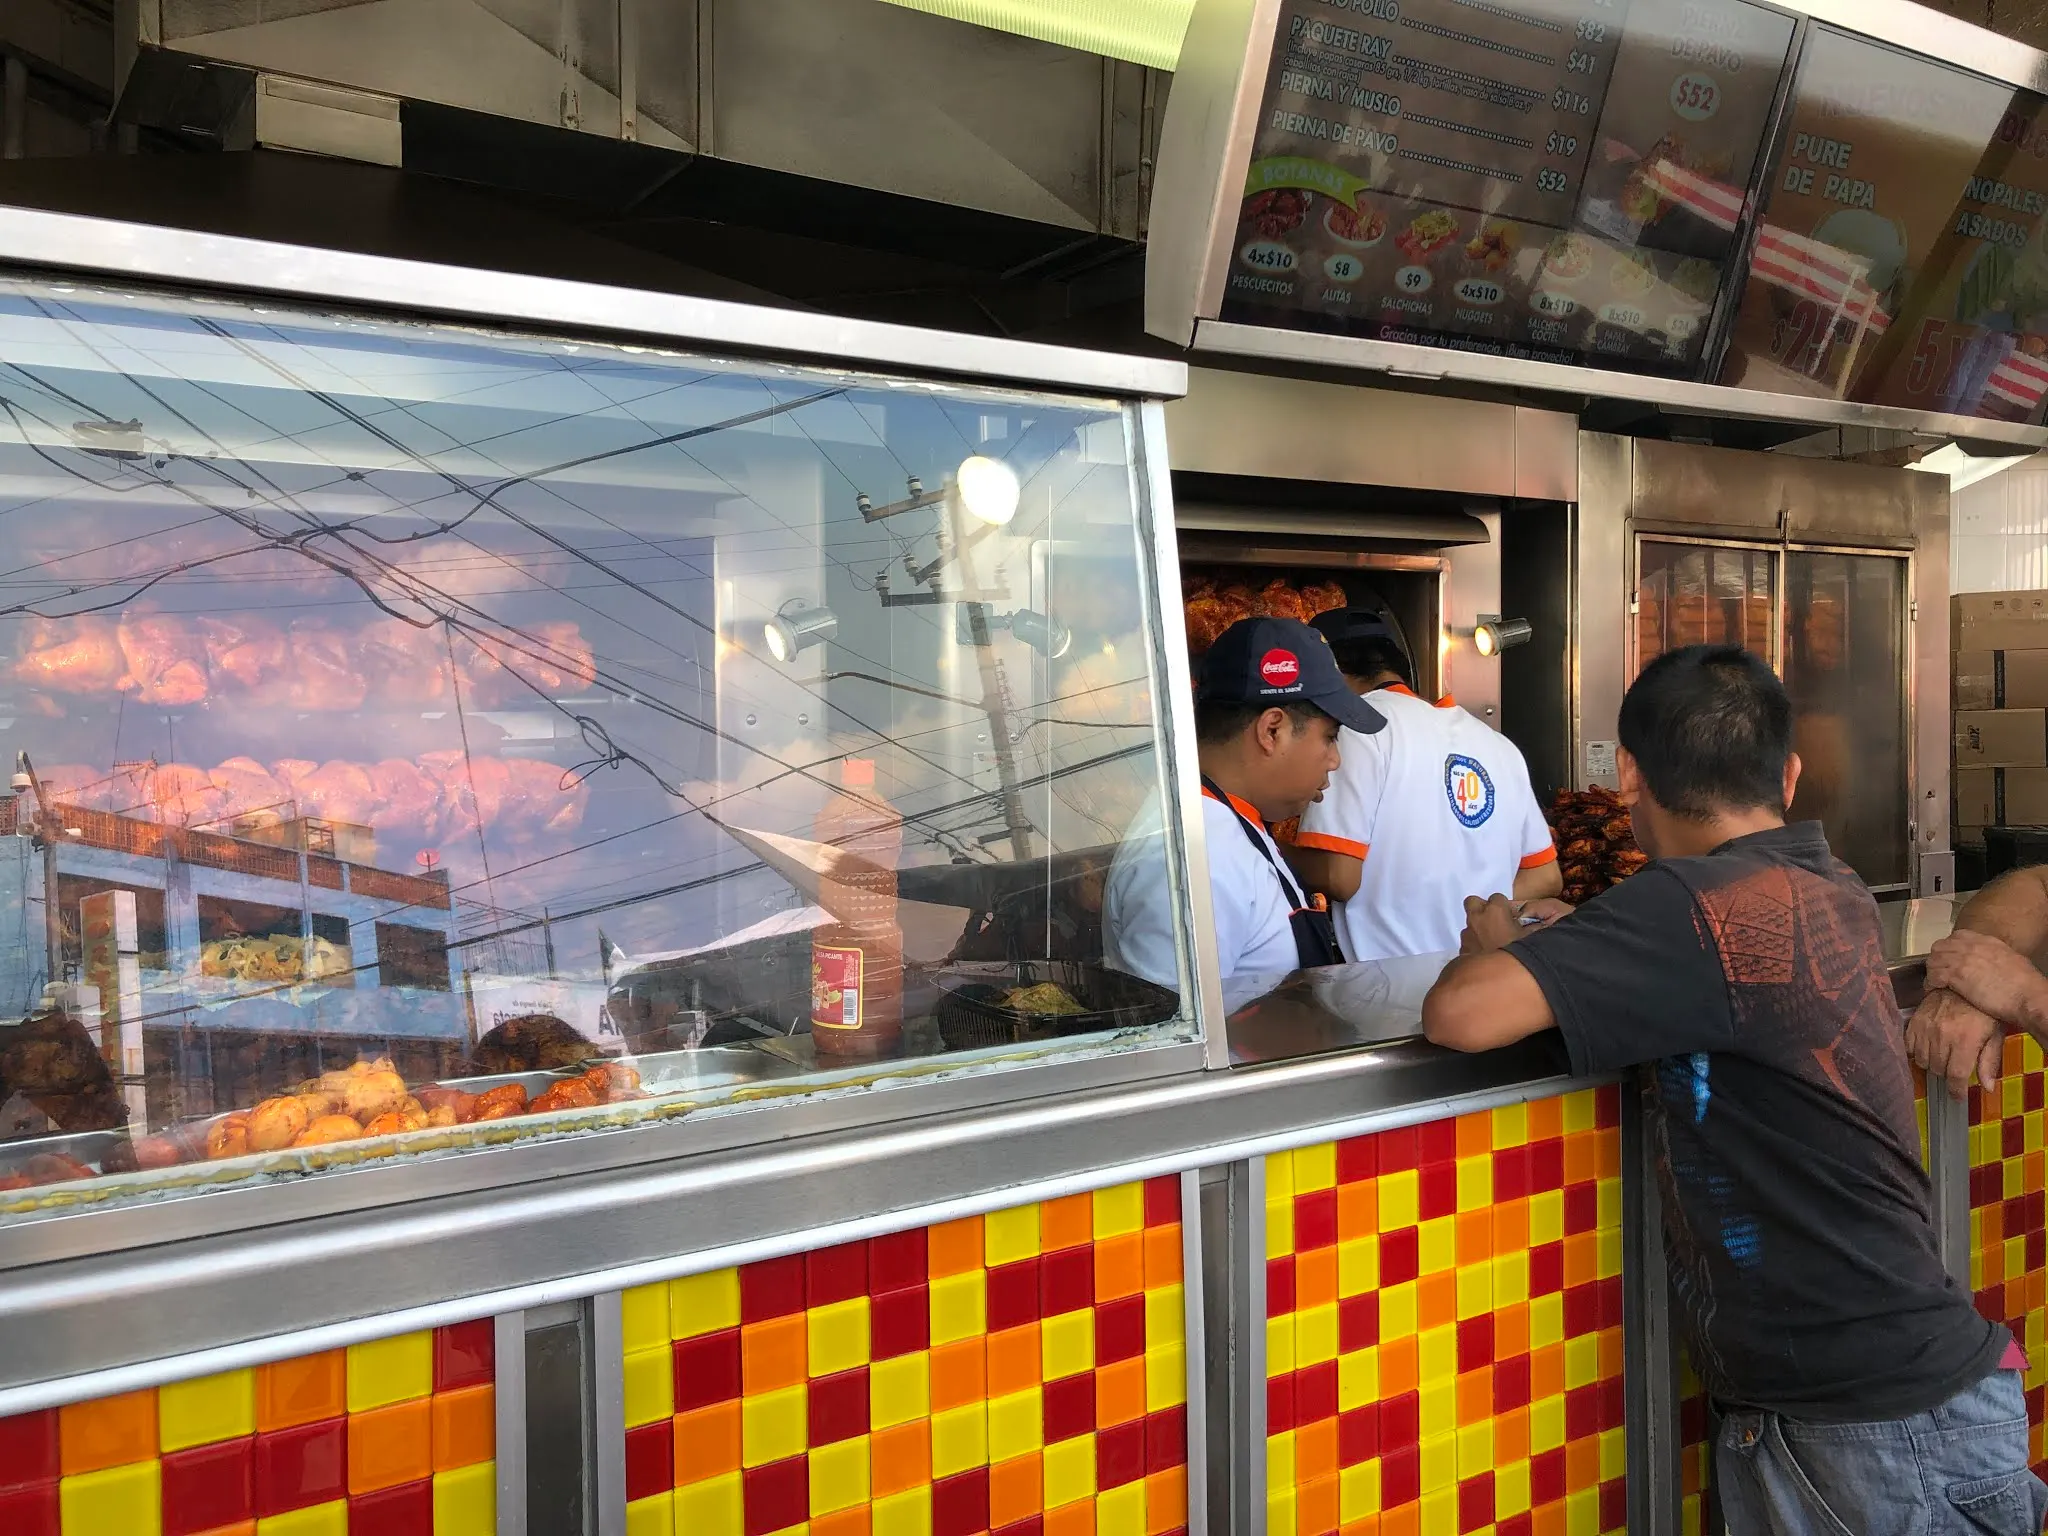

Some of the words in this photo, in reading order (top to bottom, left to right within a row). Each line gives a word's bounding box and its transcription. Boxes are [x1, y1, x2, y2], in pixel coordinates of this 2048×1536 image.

[1575, 17, 1606, 43] $82
[1290, 15, 1359, 51] PAQUETE
[1360, 33, 1392, 59] RAY
[1552, 88, 1589, 115] $116
[1566, 48, 1597, 75] $41
[1671, 37, 1694, 58] DE
[1698, 39, 1743, 73] PAVO
[1319, 50, 1344, 64] papas
[1462, 85, 1478, 98] vaso
[1479, 88, 1488, 100] de
[1322, 66, 1337, 77] con
[1677, 77, 1714, 112] $52
[1280, 69, 1333, 101] PIERNA
[1338, 84, 1349, 104] Y
[1350, 87, 1401, 116] MUSLO
[1546, 130, 1577, 157] $19
[1272, 110, 1328, 139] PIERNA
[1331, 122, 1352, 144] DE
[1354, 127, 1398, 154] PAVO
[1537, 167, 1567, 192] $52
[1791, 132, 1852, 169] PURE
[1263, 163, 1345, 193] BOTANAS
[1783, 165, 1816, 195] DE
[1822, 173, 1875, 208] PAPA
[1964, 174, 2045, 215] NOPALES
[1955, 210, 2028, 248] ASADOS
[1248, 248, 1292, 269] 4x$10
[1334, 260, 1351, 277] $8
[1232, 275, 1293, 296] PESCUECITOS
[1405, 272, 1421, 288] $9
[1461, 284, 1498, 301] 4x$10
[1381, 297, 1433, 315] SALCHICHAS
[1455, 308, 1494, 324] NUGGETS
[1380, 325, 1418, 343] Gracias
[1419, 335, 1437, 348] por
[1440, 334, 1449, 346] tu
[1263, 660, 1298, 674] Coca-Cola
[1457, 771, 1478, 815] 40
